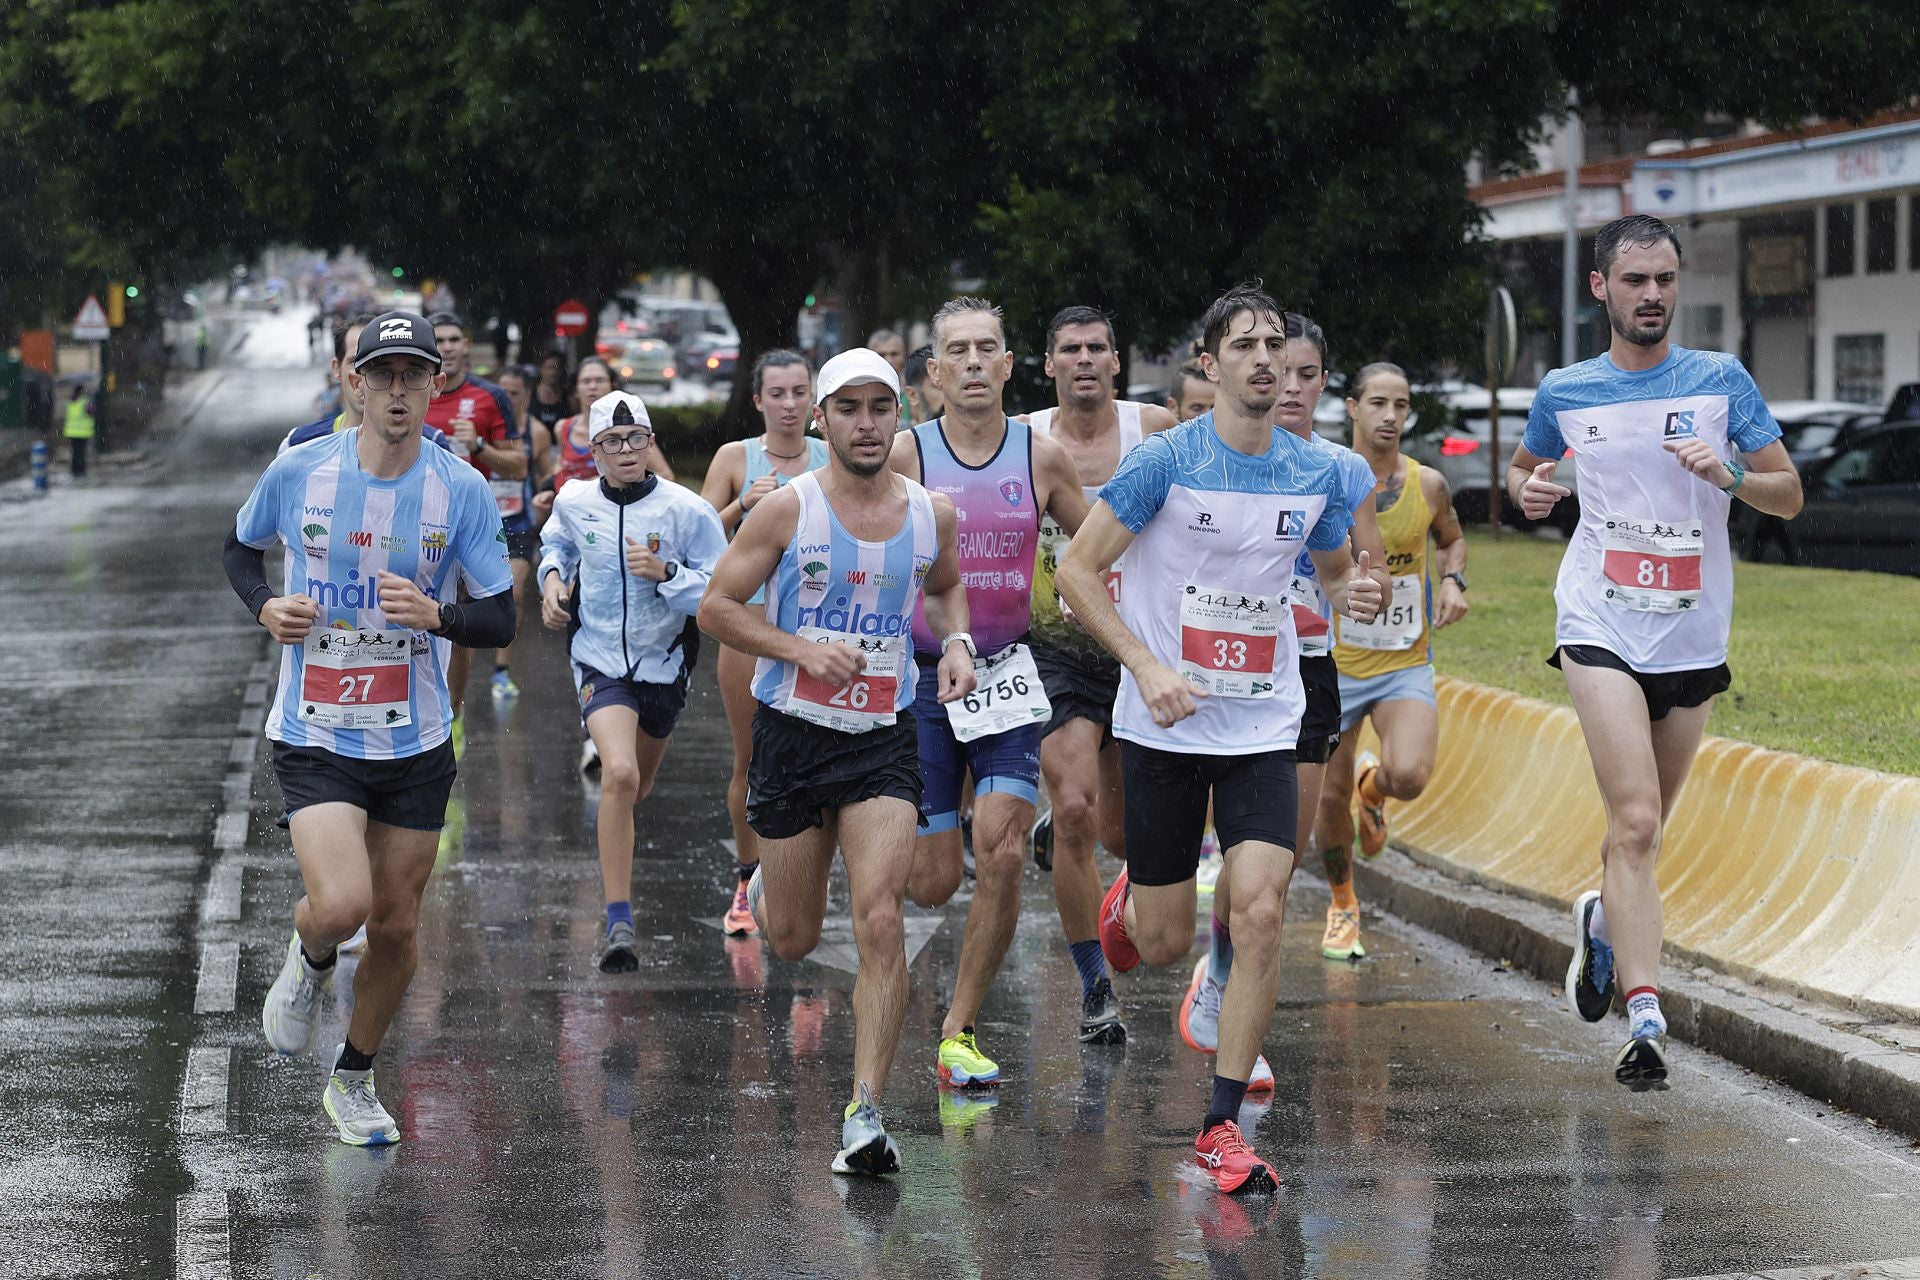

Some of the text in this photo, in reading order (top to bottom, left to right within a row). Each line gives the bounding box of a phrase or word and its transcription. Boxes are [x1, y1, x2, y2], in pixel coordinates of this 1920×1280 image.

[305, 505, 334, 517] vive
[1275, 510, 1306, 535] CS
[381, 535, 407, 545] metro
[801, 544, 831, 555] vive
[957, 531, 1024, 559] RANQUERO
[1637, 560, 1669, 588] 81
[1213, 639, 1247, 669] 33
[338, 674, 375, 702] 27
[829, 682, 870, 709] 26
[963, 675, 1028, 714] 6756
